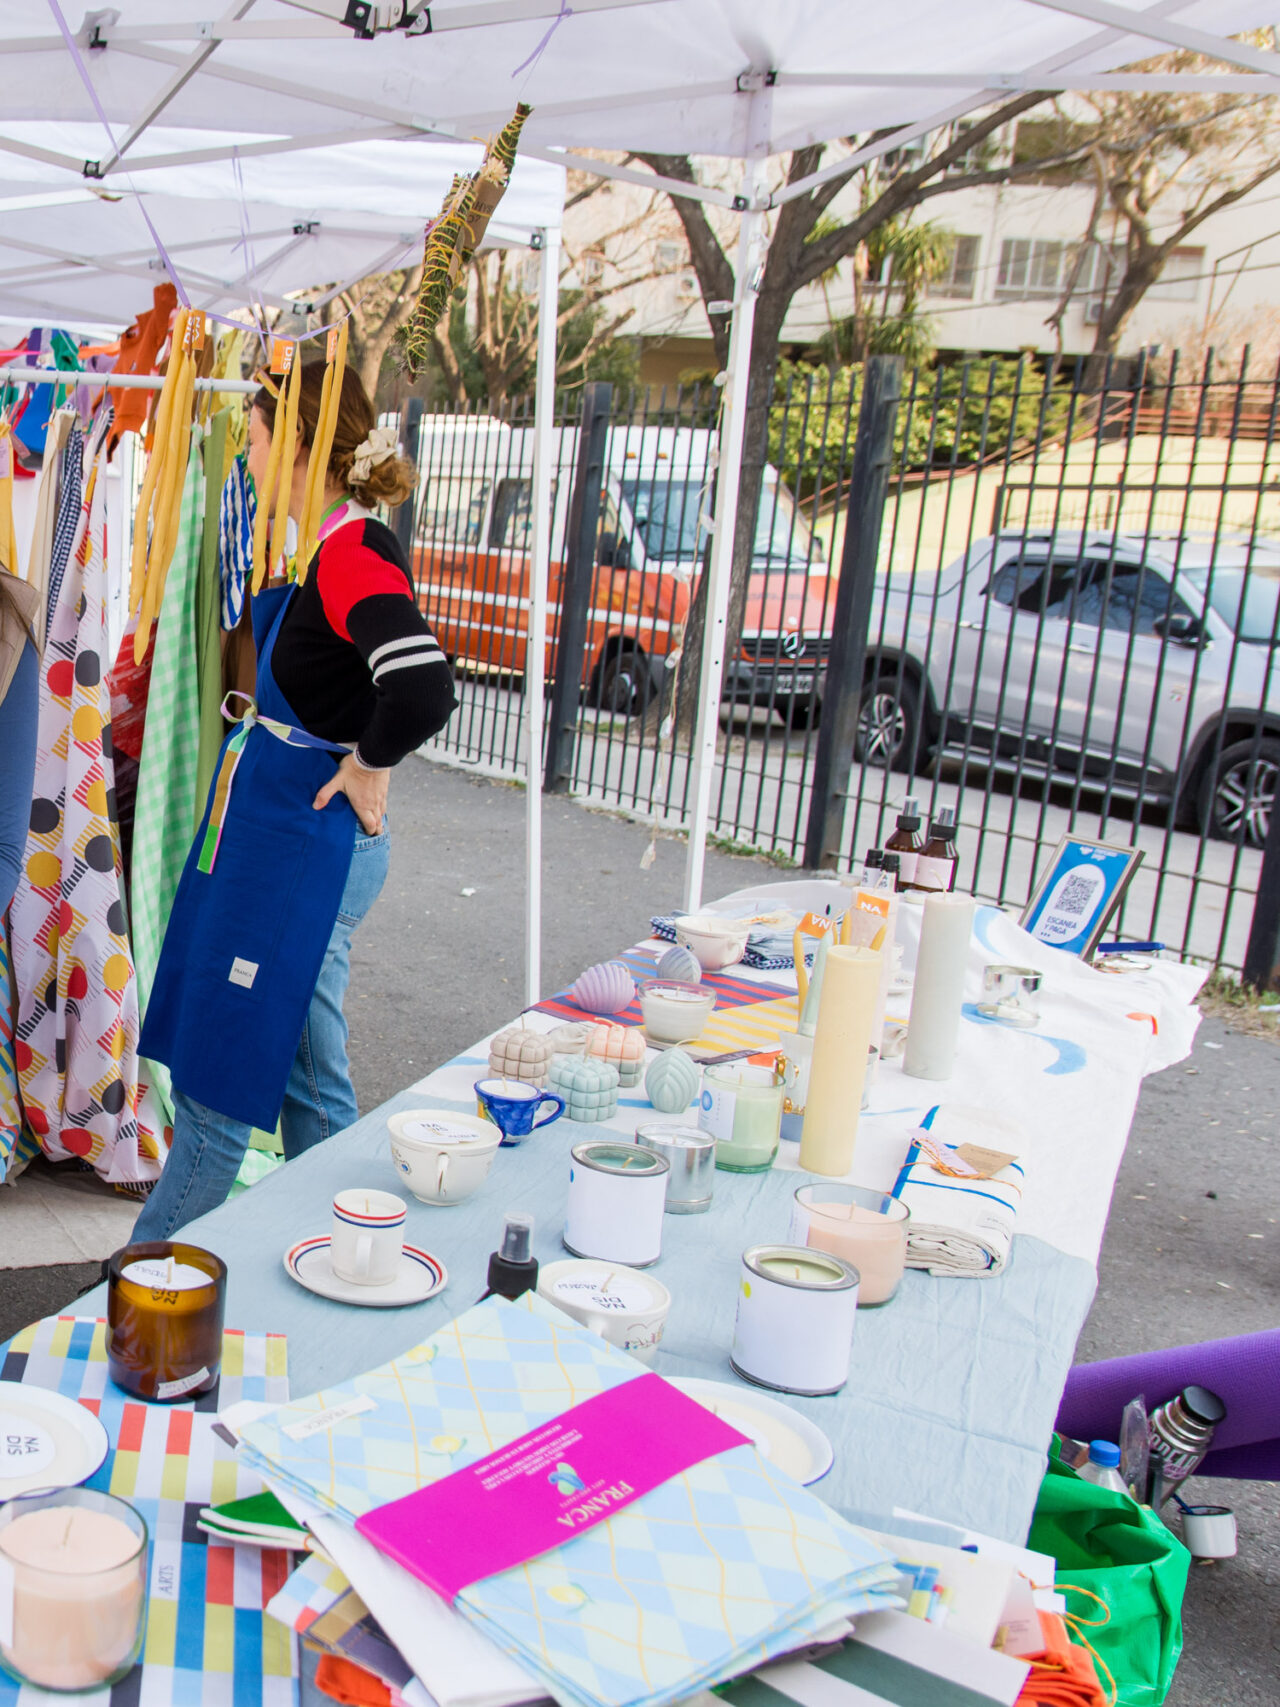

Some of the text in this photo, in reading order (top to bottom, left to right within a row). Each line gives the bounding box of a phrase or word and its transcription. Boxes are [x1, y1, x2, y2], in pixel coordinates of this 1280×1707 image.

[283, 346, 293, 370] DIS
[860, 902, 881, 915] NA
[811, 915, 830, 929] NA
[233, 967, 252, 978] FRANCA
[152, 1294, 177, 1305] NA
[592, 1296, 622, 1304] DIS
[6, 1434, 22, 1456] DIS
[23, 1435, 40, 1454] NA
[557, 1480, 635, 1527] FRANCA
[158, 1564, 174, 1596] ARTS
